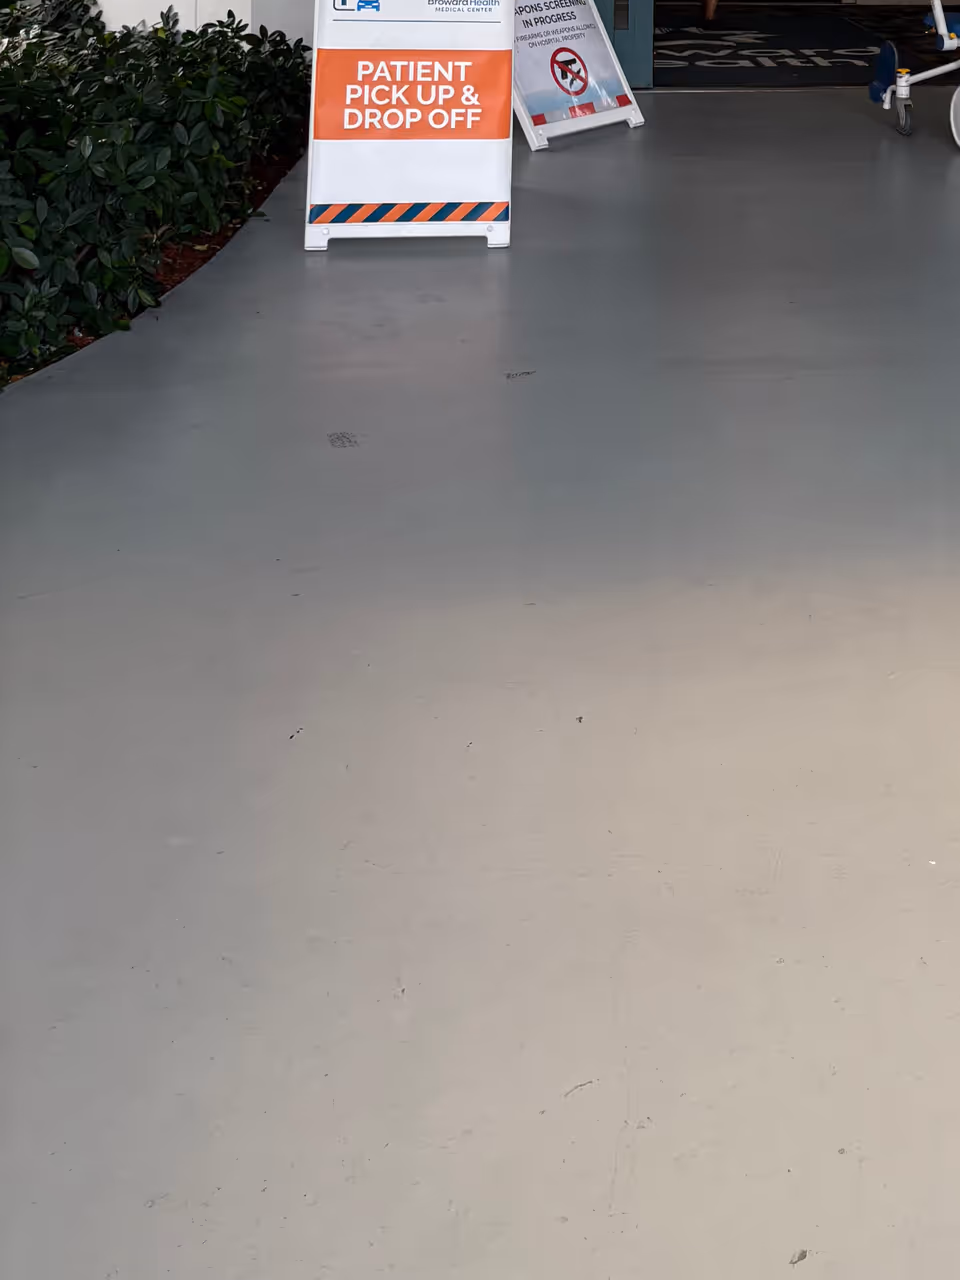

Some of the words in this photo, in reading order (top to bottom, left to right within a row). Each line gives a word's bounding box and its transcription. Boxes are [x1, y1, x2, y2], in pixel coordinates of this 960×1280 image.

[515, 3, 543, 16] APONS
[522, 19, 533, 28] IN
[534, 11, 577, 26] PROGRESS
[516, 31, 543, 42] FIREARMS
[551, 26, 576, 36] WEAPONS
[562, 32, 586, 42] PROPERTY
[357, 61, 473, 82] PATIENT
[345, 84, 410, 105] PICK
[417, 85, 455, 105] UP
[461, 85, 481, 105] &
[343, 108, 422, 129] DROP
[428, 108, 482, 129] OFF
